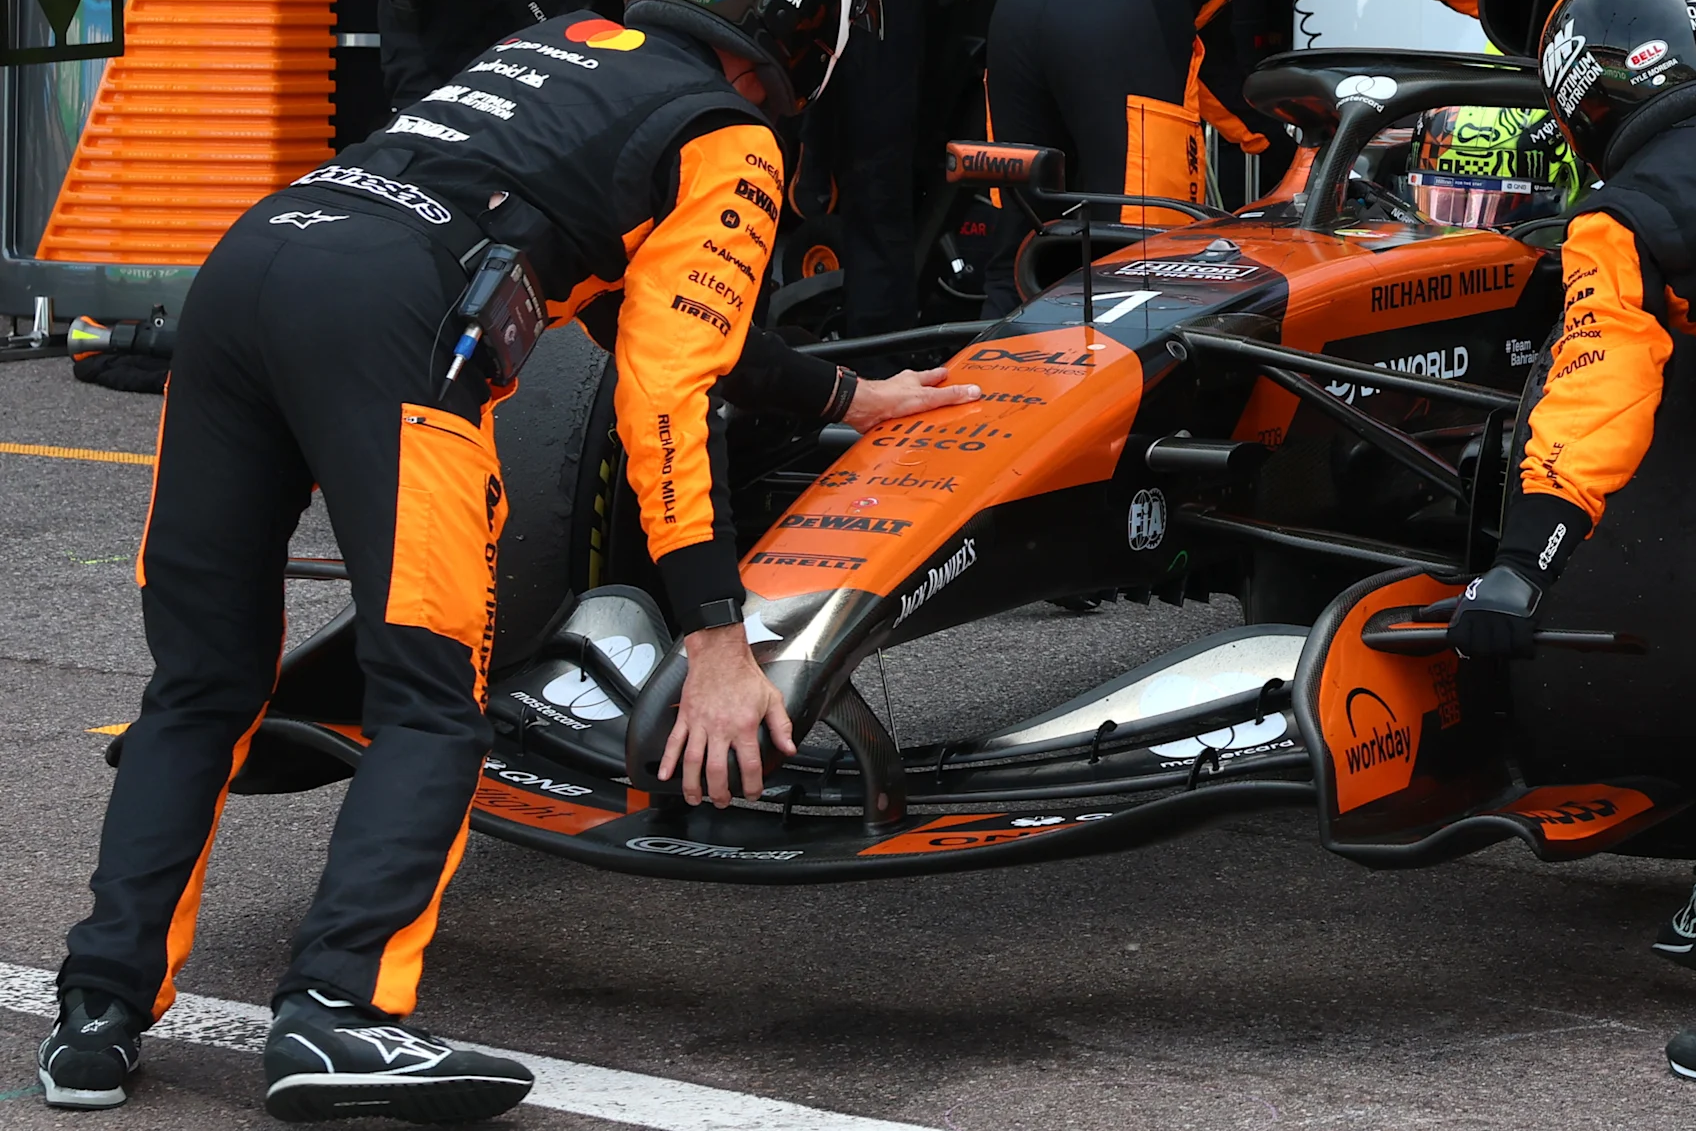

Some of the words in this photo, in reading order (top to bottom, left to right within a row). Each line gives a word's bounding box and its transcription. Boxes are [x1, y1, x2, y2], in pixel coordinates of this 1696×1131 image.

[537, 45, 599, 70] WORLD
[1631, 45, 1662, 64] BELL
[1556, 51, 1597, 108] OPTIMUM
[1629, 73, 1648, 86] KYLE
[1647, 58, 1679, 80] MOREIRA
[468, 91, 516, 110] OPTIMUM
[1564, 63, 1604, 118] NUTRITION
[458, 97, 515, 121] NUTRITION
[962, 151, 1024, 175] allwyn
[1138, 262, 1241, 275] Hilton
[688, 269, 744, 312] alteryx
[1371, 274, 1451, 312] RICHARD
[1459, 264, 1515, 295] MILLE
[671, 294, 732, 338] PIRELLI
[1091, 290, 1163, 324] 1
[968, 348, 1097, 368] DELL
[1505, 339, 1532, 353] #Team
[962, 362, 1086, 378] Technologies
[657, 413, 675, 475] RICHARD
[872, 436, 987, 452] CISCO
[867, 473, 960, 494] rubrik
[661, 480, 677, 525] MILLE
[776, 514, 913, 537] DEWALT
[747, 552, 868, 570] PIRELLI
[893, 578, 929, 629] JACK
[510, 690, 594, 731] mastercard
[1345, 722, 1412, 776] workday
[498, 770, 594, 797] QNB
